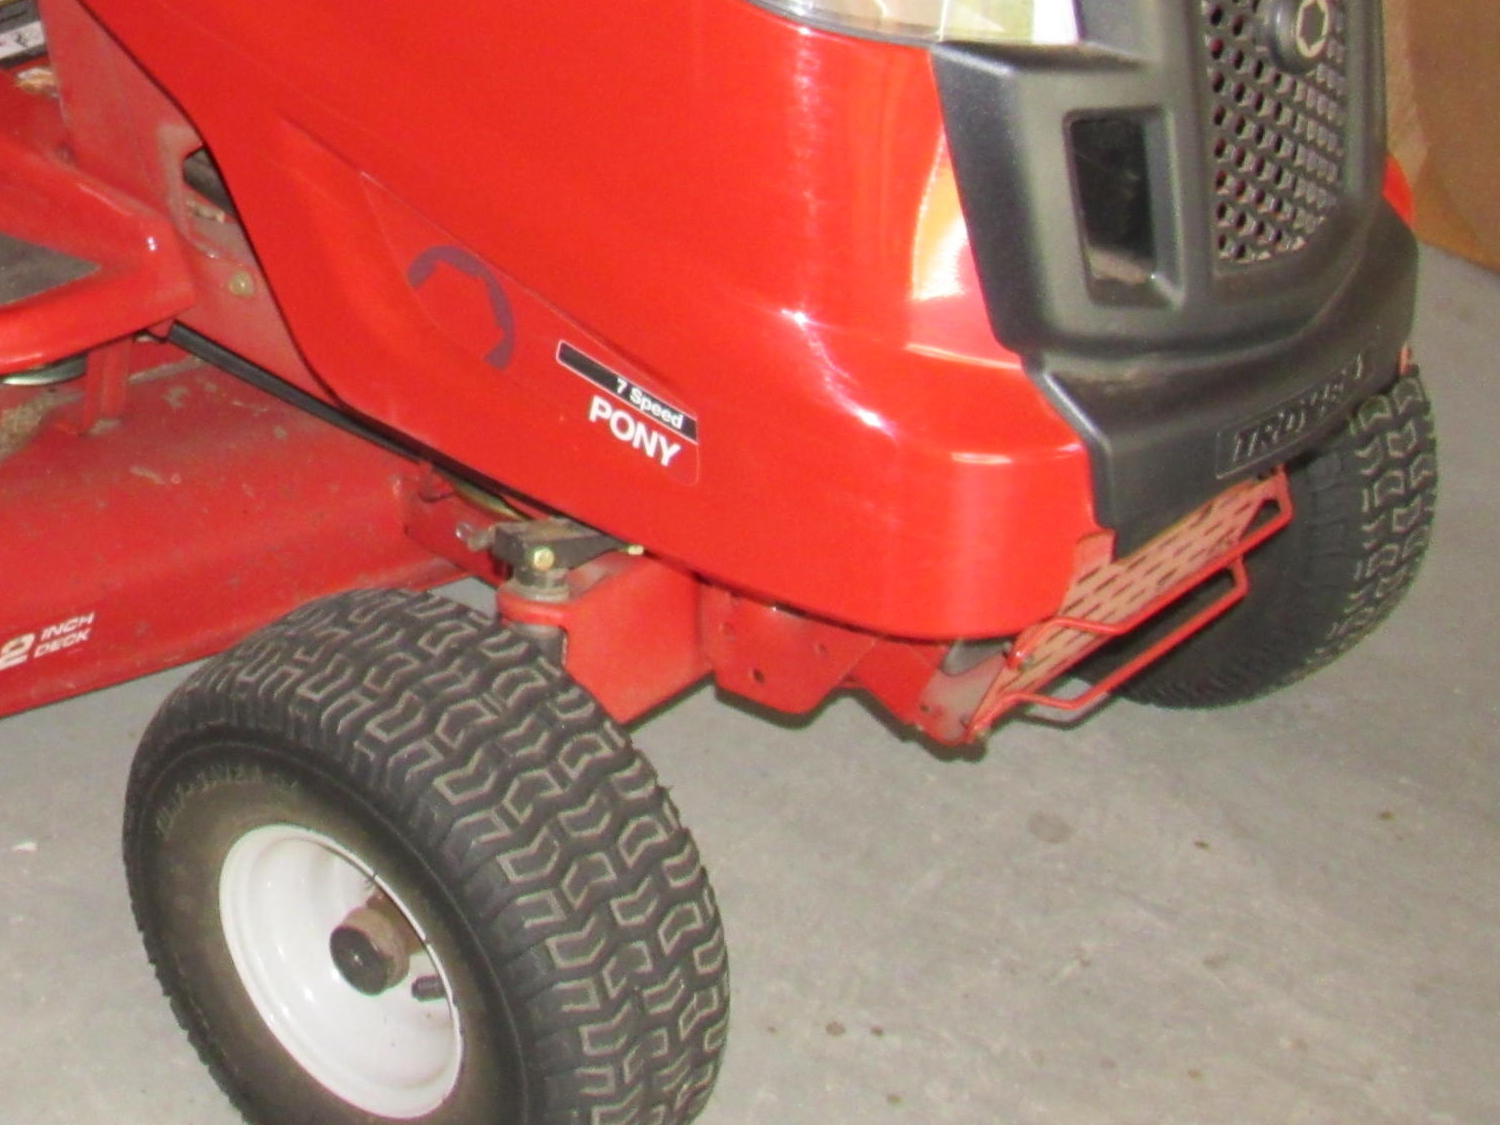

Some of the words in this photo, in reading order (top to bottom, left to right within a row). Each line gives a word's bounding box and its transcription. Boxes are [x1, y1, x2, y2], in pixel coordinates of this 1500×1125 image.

[615, 376, 629, 395] 7
[628, 386, 684, 430] Speed
[587, 393, 683, 468] PONY
[32, 627, 92, 659] DECK
[40, 610, 96, 642] INCH
